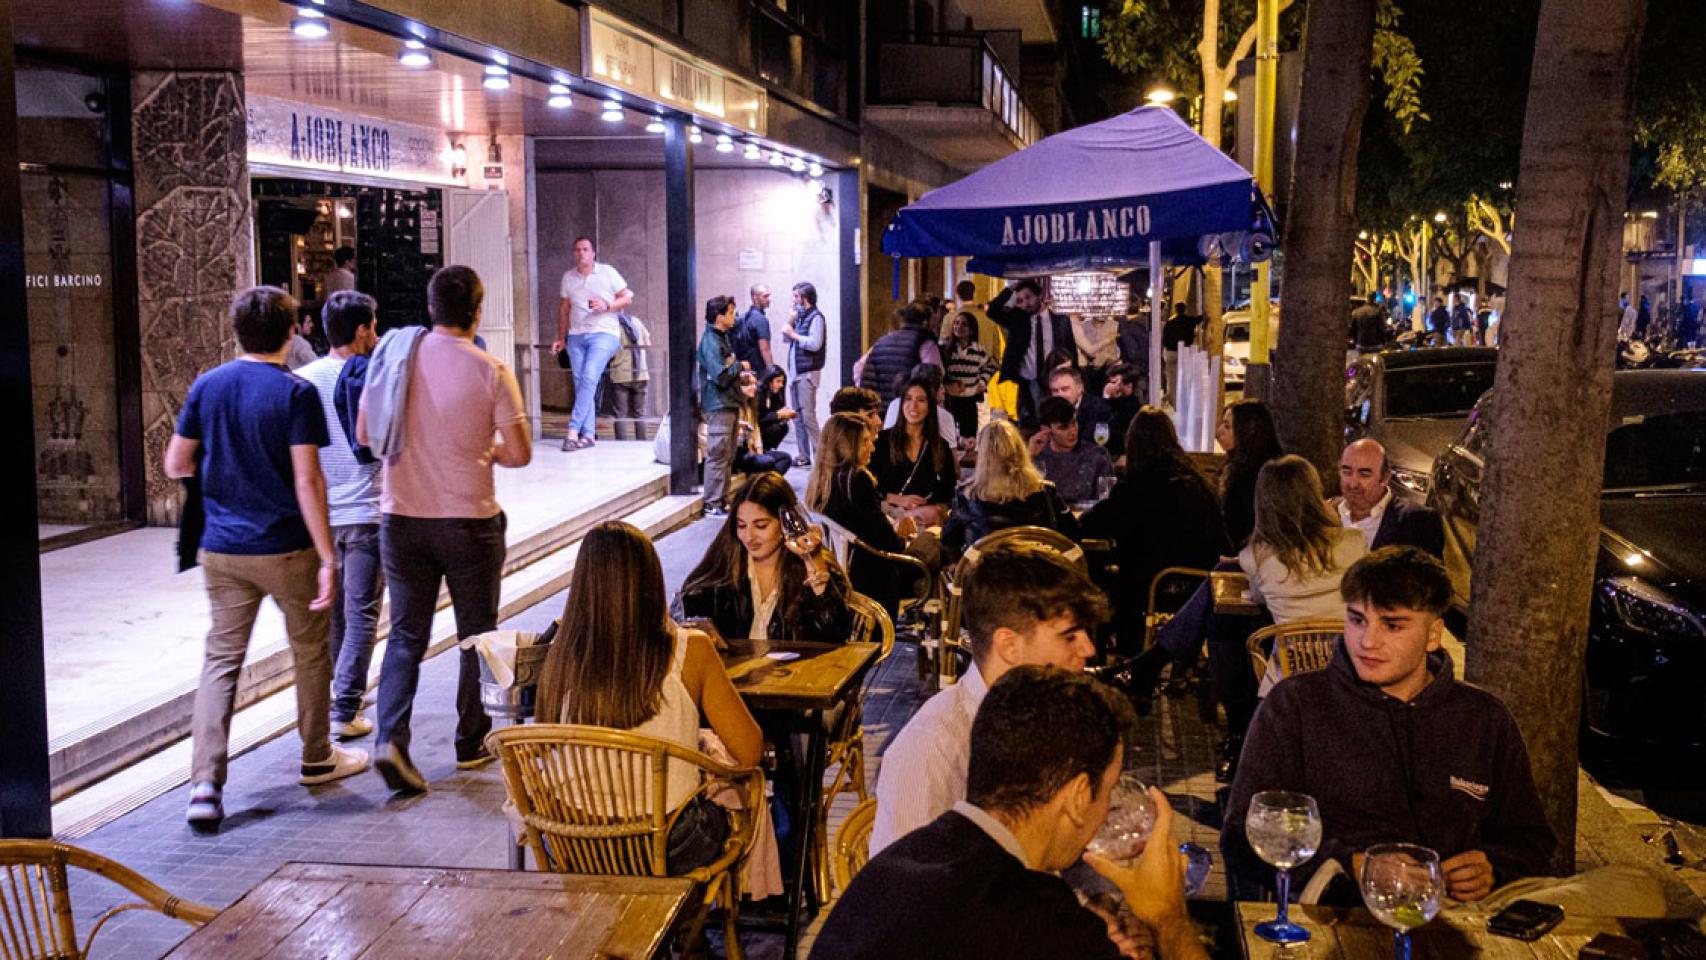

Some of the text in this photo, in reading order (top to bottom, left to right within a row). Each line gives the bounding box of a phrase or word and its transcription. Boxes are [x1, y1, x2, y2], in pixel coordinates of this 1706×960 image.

[291, 111, 390, 172] AJOBLANCO
[1001, 205, 1151, 246] AJOBLANCO
[25, 274, 102, 288] FICI BARCINO
